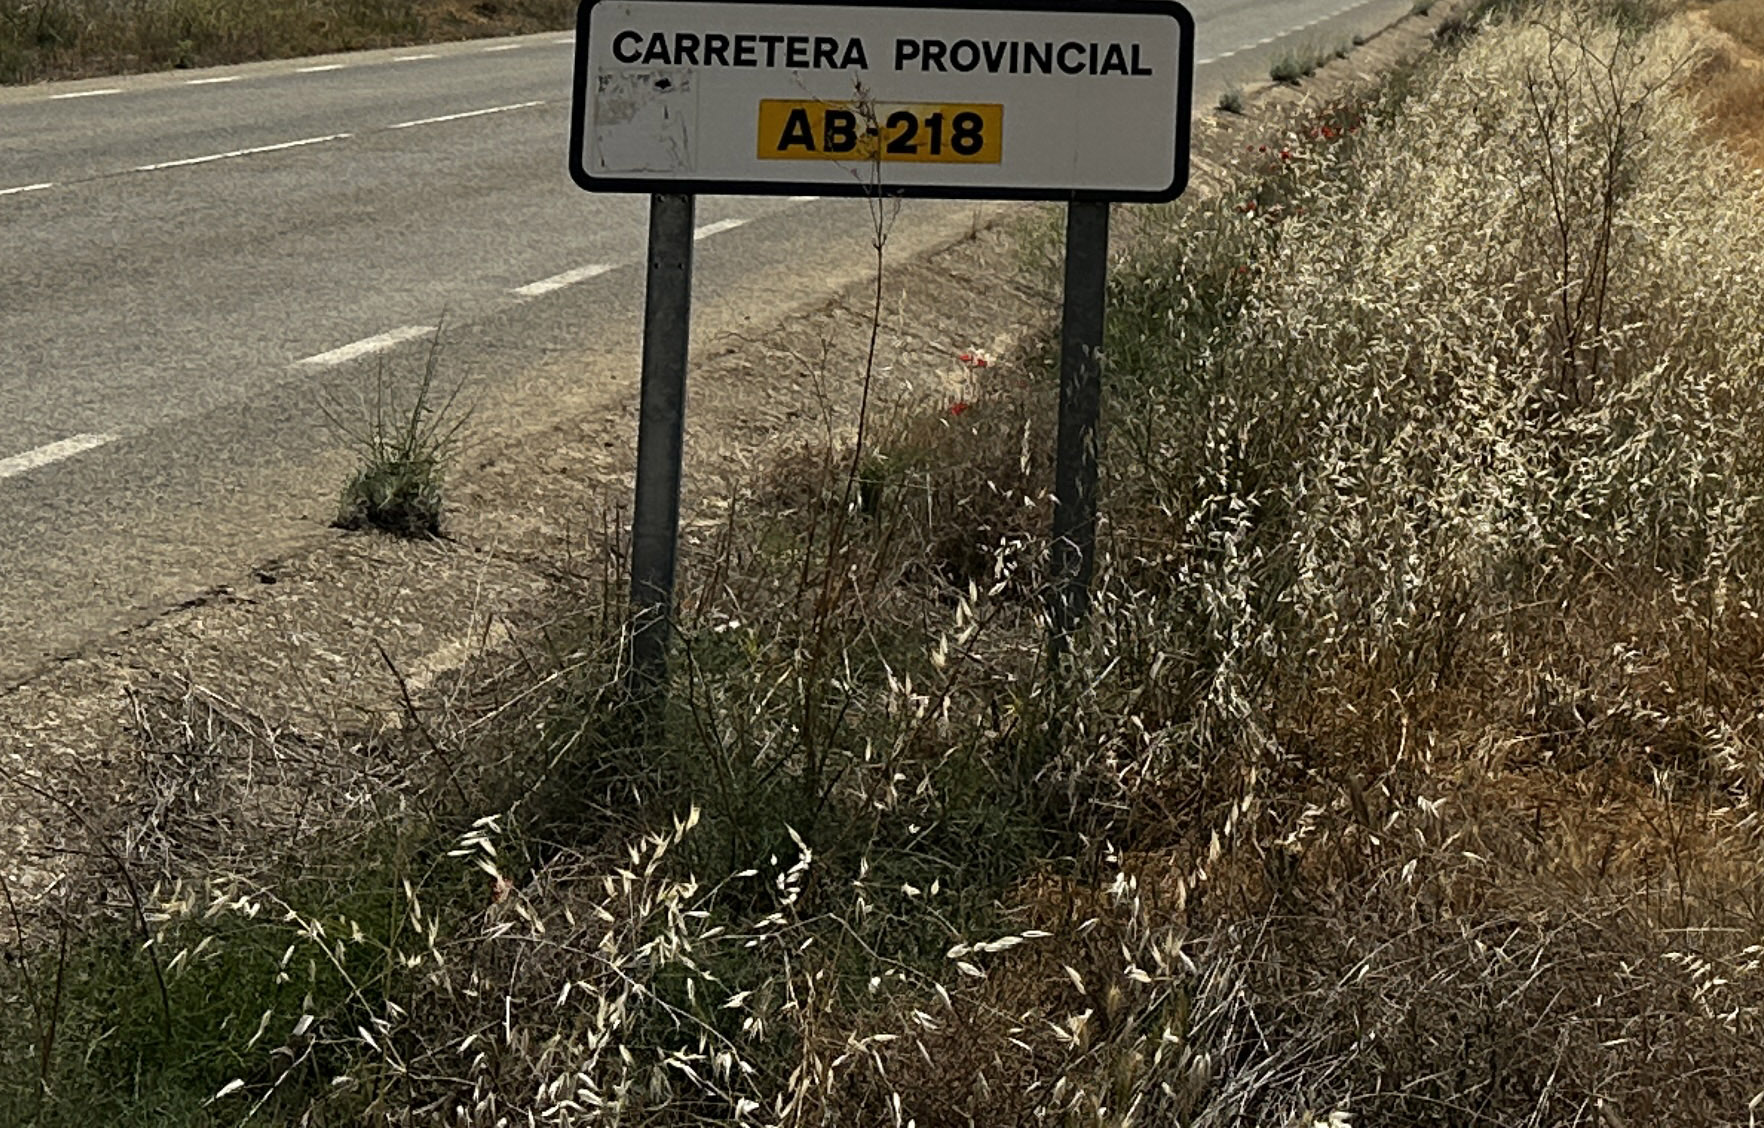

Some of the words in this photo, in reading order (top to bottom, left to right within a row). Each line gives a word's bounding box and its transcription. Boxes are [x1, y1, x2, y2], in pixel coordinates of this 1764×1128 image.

[612, 30, 868, 70] CARRETERA
[894, 38, 1153, 76] PROVINCIAL
[776, 108, 985, 156] AB-218
